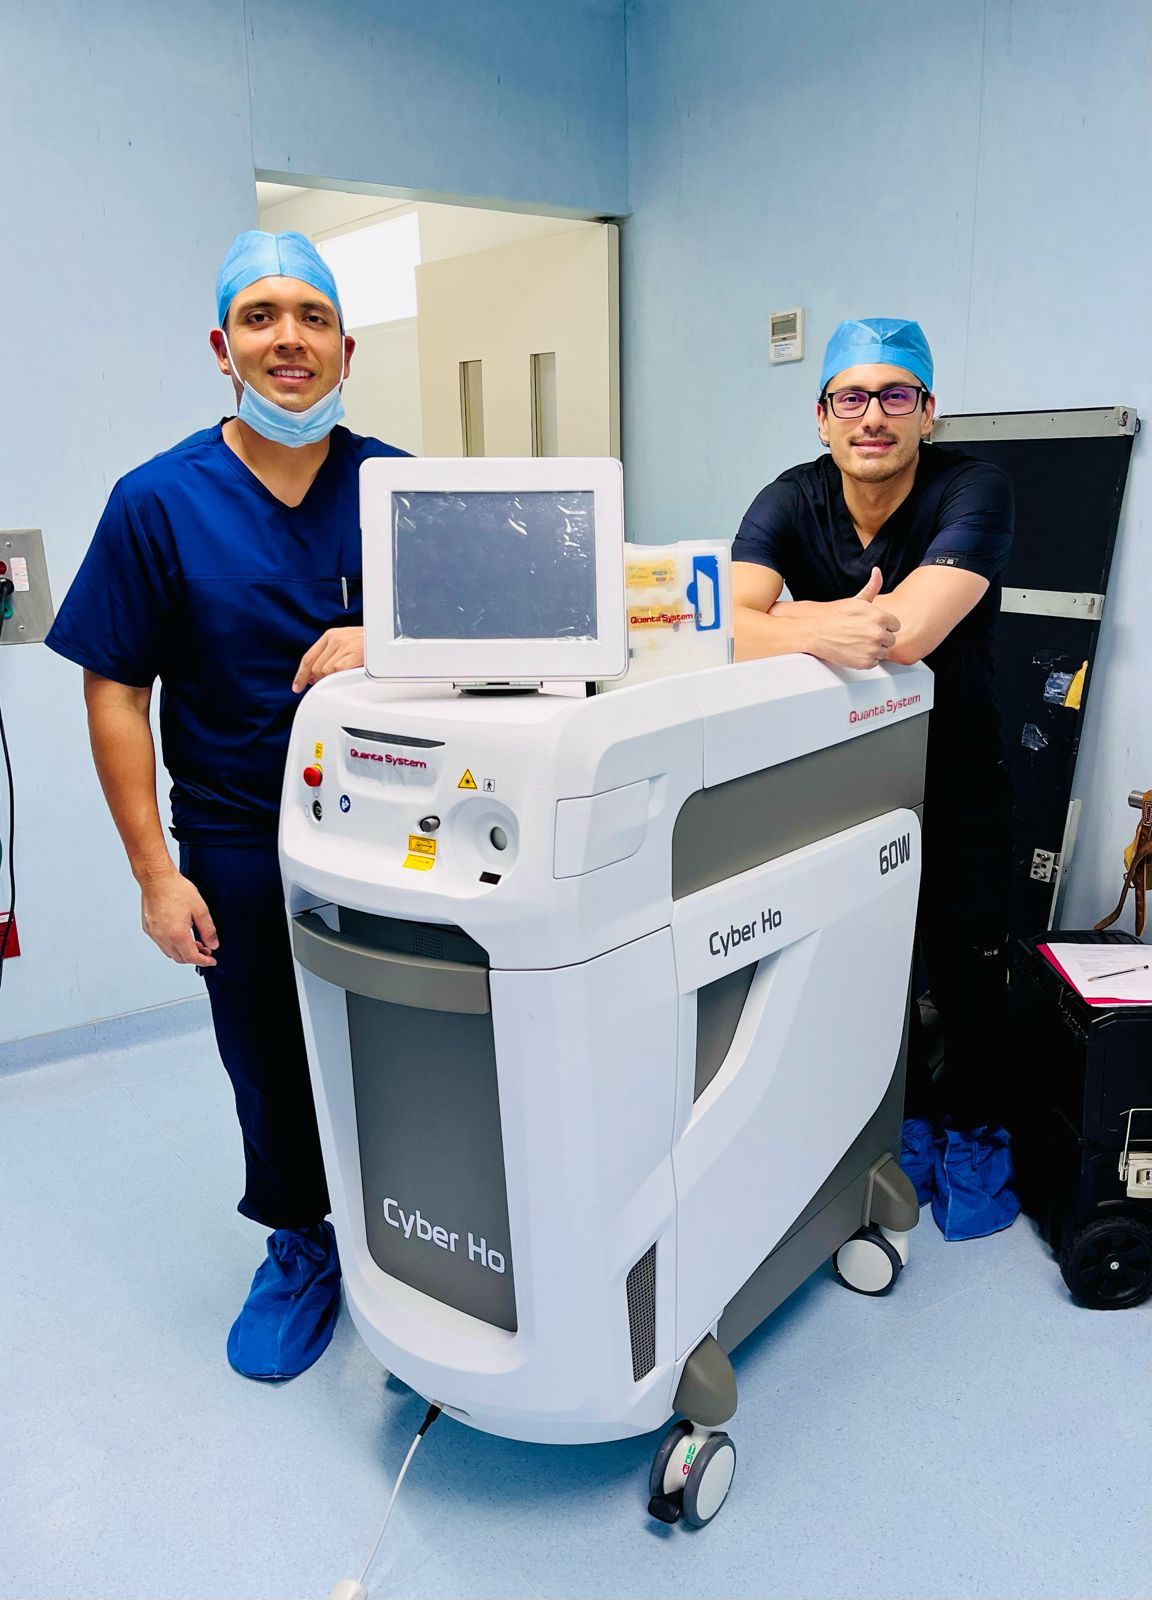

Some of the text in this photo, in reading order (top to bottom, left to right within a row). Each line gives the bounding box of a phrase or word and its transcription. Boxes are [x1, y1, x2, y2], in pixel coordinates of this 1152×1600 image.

[630, 616, 661, 624] Quanta
[661, 613, 693, 624] System
[849, 694, 921, 723] Quanta System
[350, 748, 427, 768] Quanta System
[879, 832, 910, 875] 60W
[709, 908, 782, 957] Cyber Ho
[383, 1197, 506, 1274] Cyber Ho
